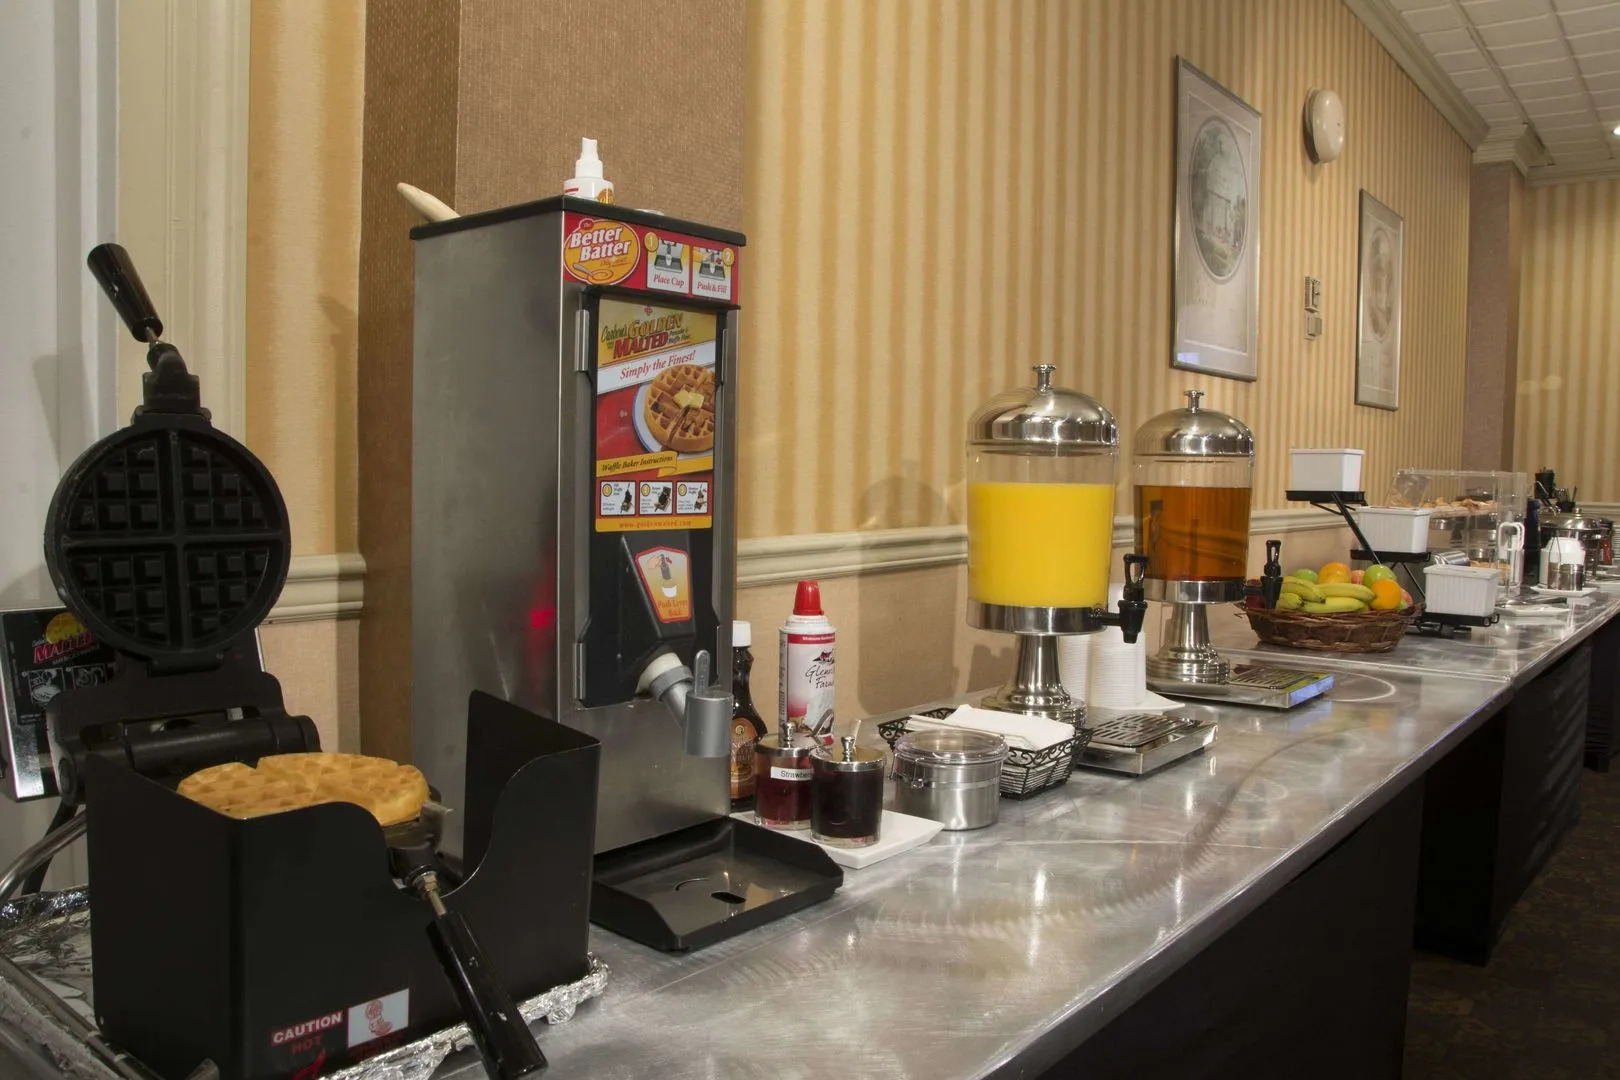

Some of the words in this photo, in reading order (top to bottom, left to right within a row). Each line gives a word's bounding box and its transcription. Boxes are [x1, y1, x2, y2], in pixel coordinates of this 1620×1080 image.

[570, 227, 622, 248] Better
[580, 241, 631, 261] Batter
[653, 274, 670, 285] Place
[671, 276, 685, 288] Cup
[697, 281, 712, 291] Push
[716, 284, 727, 293] Fill
[613, 332, 669, 359] MALTED
[620, 362, 651, 380] Simply
[652, 359, 666, 371] the
[667, 349, 697, 367] Finest!
[602, 463, 621, 471] Waffle
[622, 460, 639, 469] Baker
[639, 456, 673, 466] Instructions
[273, 1011, 343, 1044] CAUTION
[291, 1035, 321, 1056] HOT
